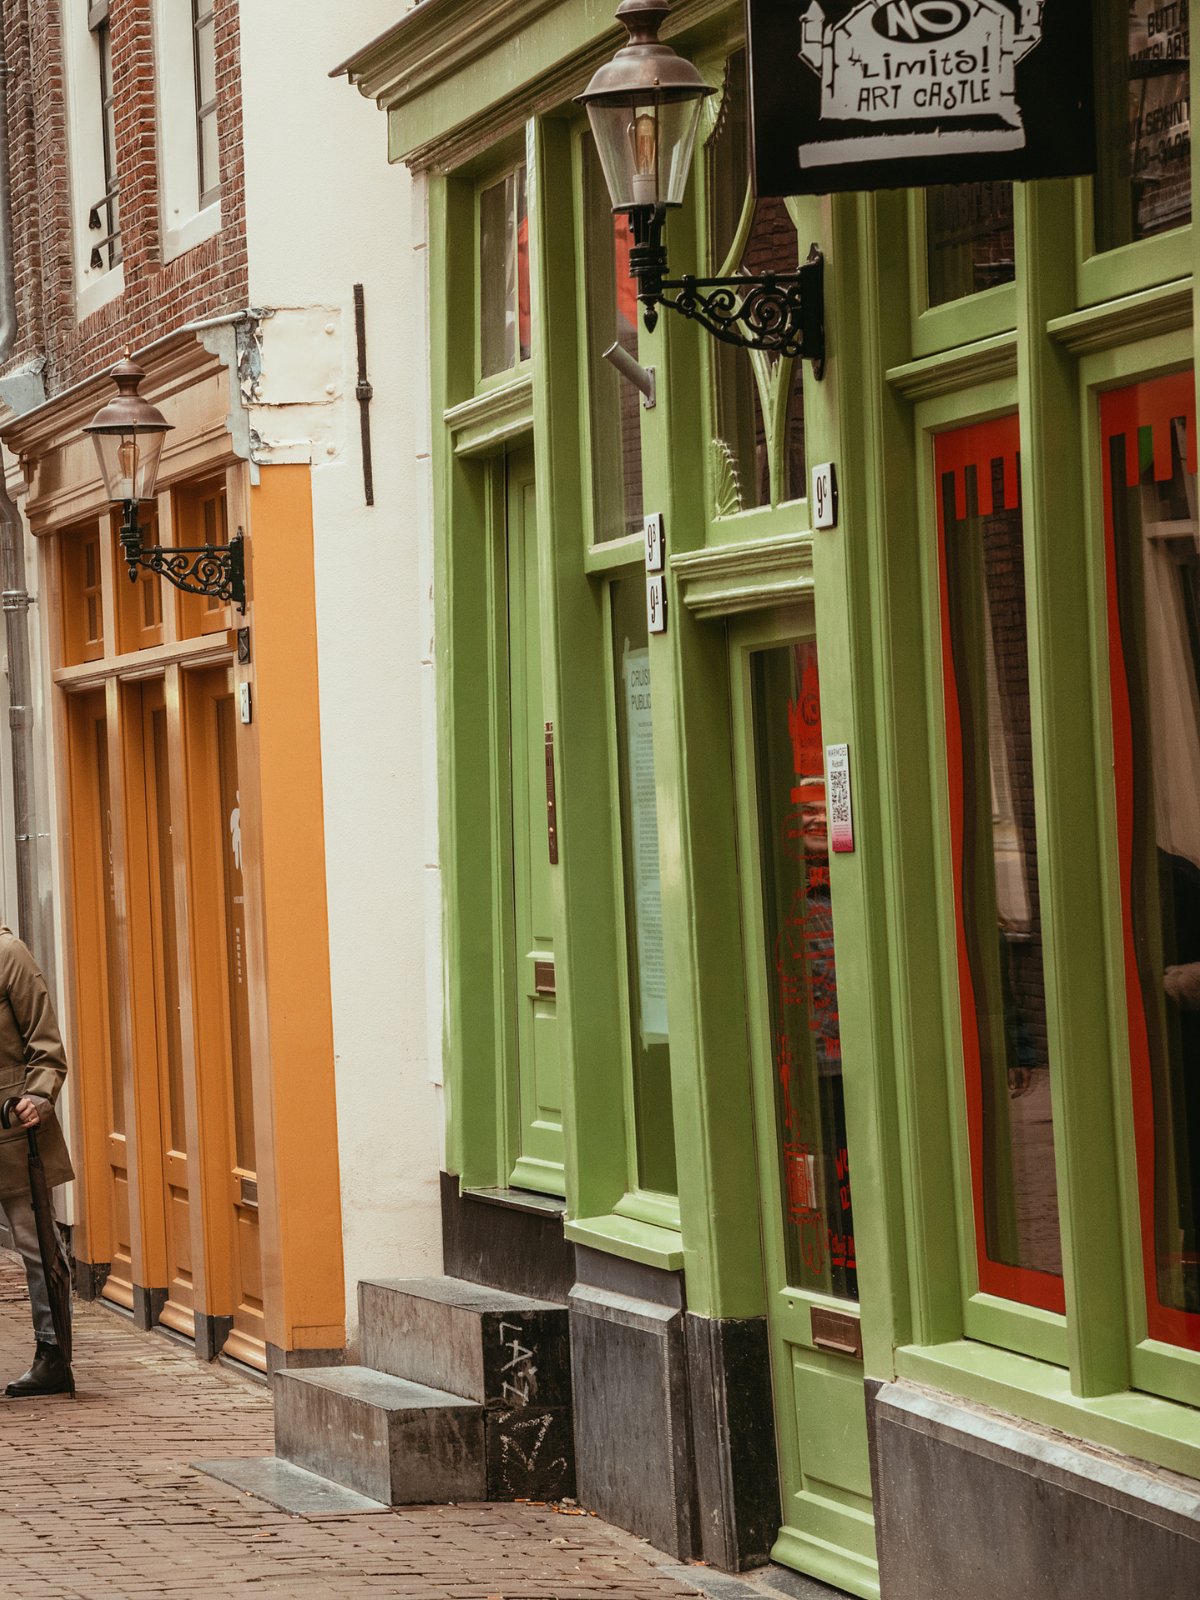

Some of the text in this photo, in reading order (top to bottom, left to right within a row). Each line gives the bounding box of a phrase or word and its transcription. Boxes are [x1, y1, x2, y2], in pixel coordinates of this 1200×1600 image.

[887, 0, 962, 40] NO
[857, 78, 991, 112] ART CASTLE
